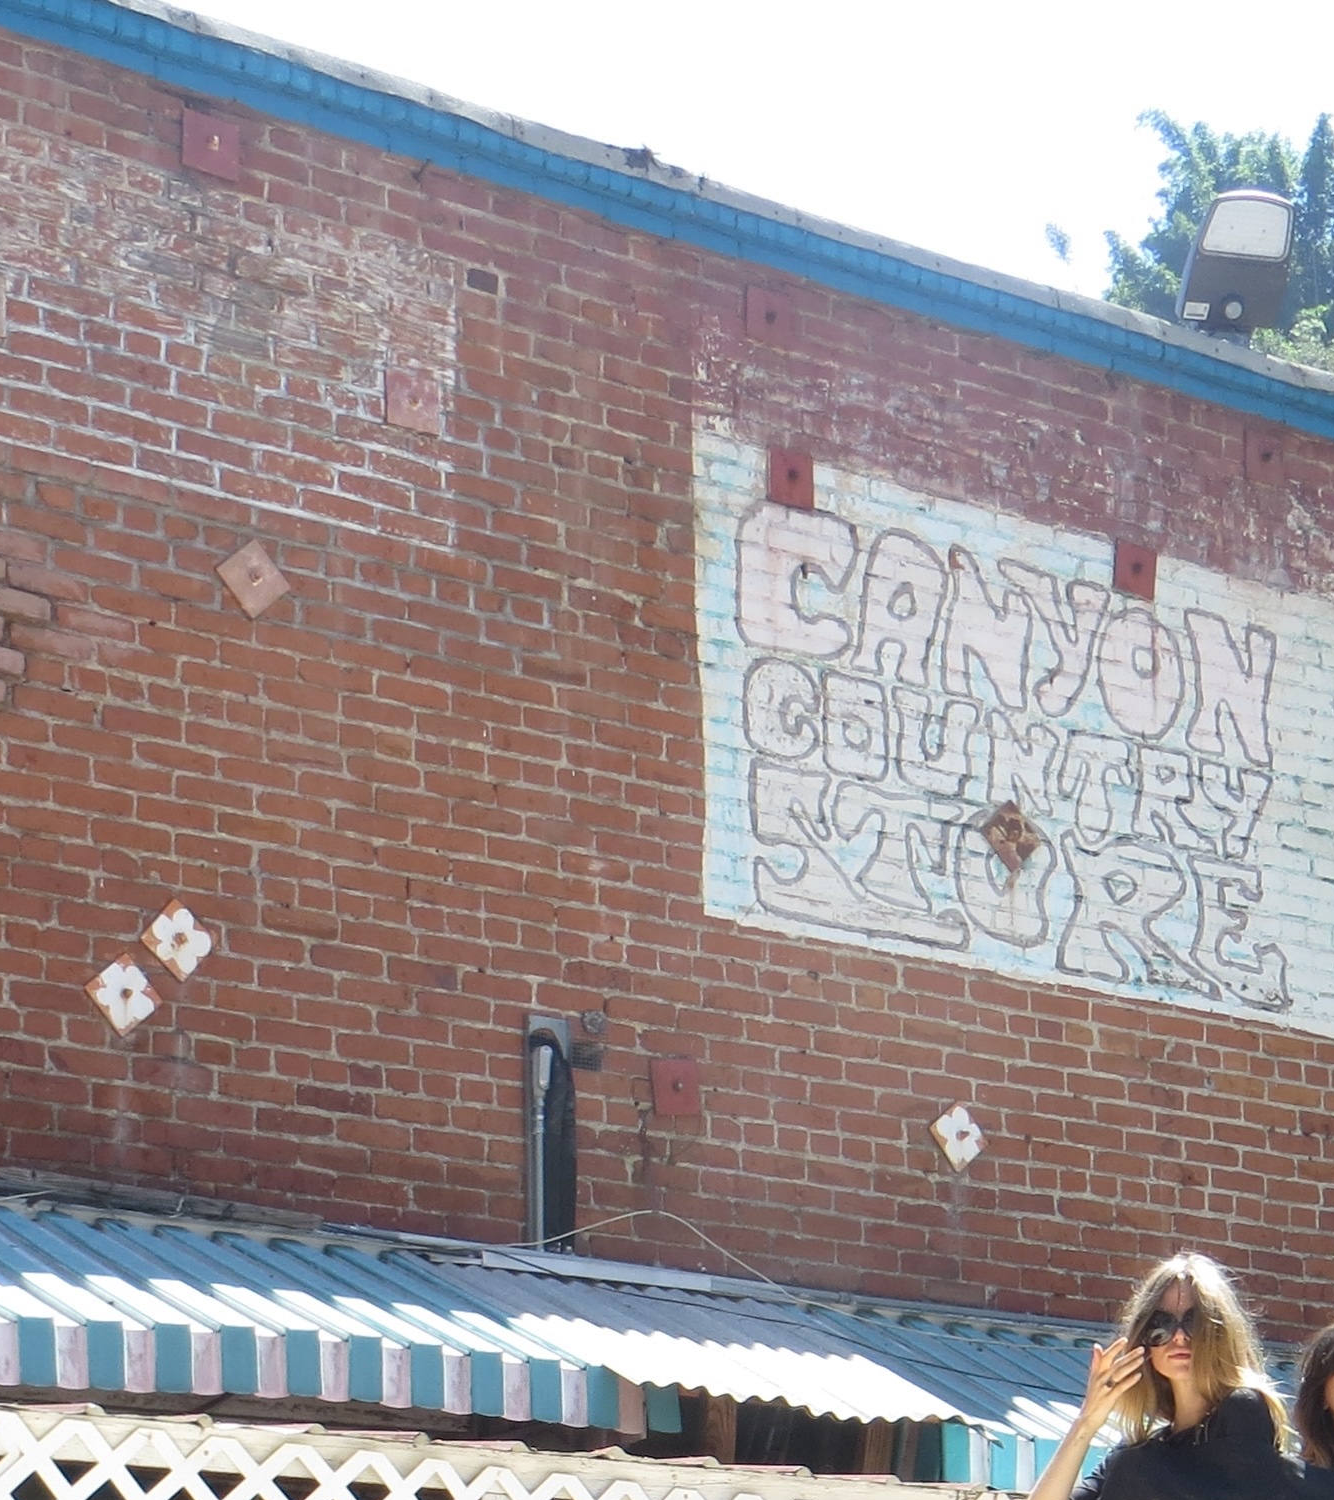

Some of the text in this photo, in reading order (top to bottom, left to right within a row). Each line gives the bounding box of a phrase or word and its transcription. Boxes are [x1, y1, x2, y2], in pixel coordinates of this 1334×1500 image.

[734, 501, 1276, 766] CANYON
[743, 656, 1273, 859] COUNTRY
[749, 757, 1292, 1012] STORE
